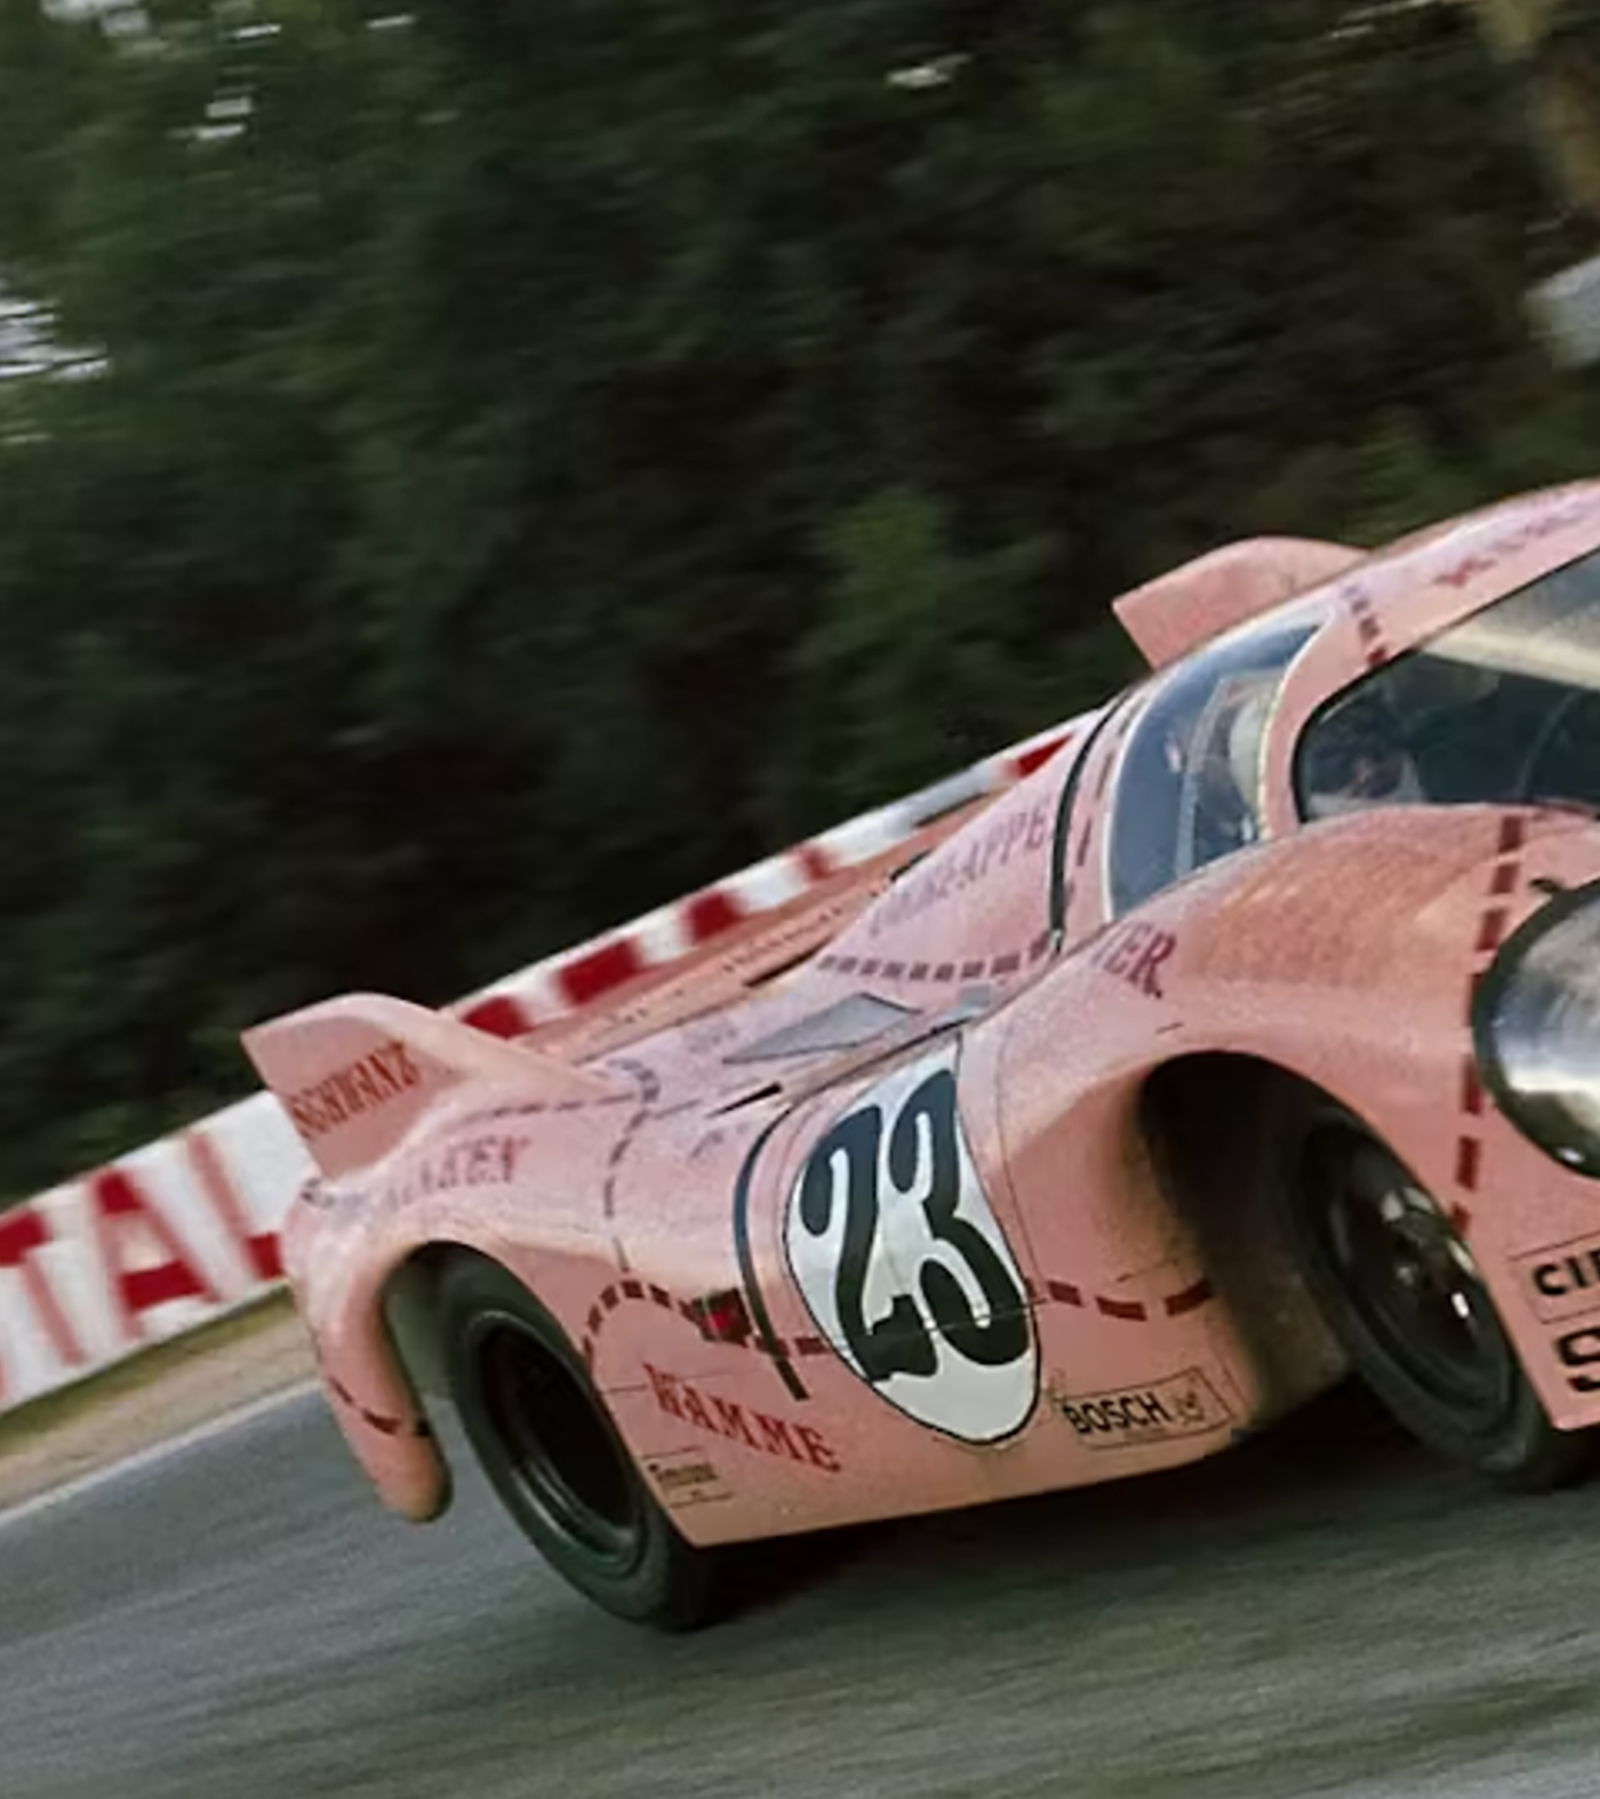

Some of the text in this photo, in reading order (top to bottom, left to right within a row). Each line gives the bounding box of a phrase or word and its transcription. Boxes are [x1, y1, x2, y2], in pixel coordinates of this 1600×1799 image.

[0, 1130, 284, 1400] TAL
[799, 1069, 1030, 1382] 23
[642, 1361, 841, 1473] WAMME
[1062, 1391, 1174, 1434] BOSCH
